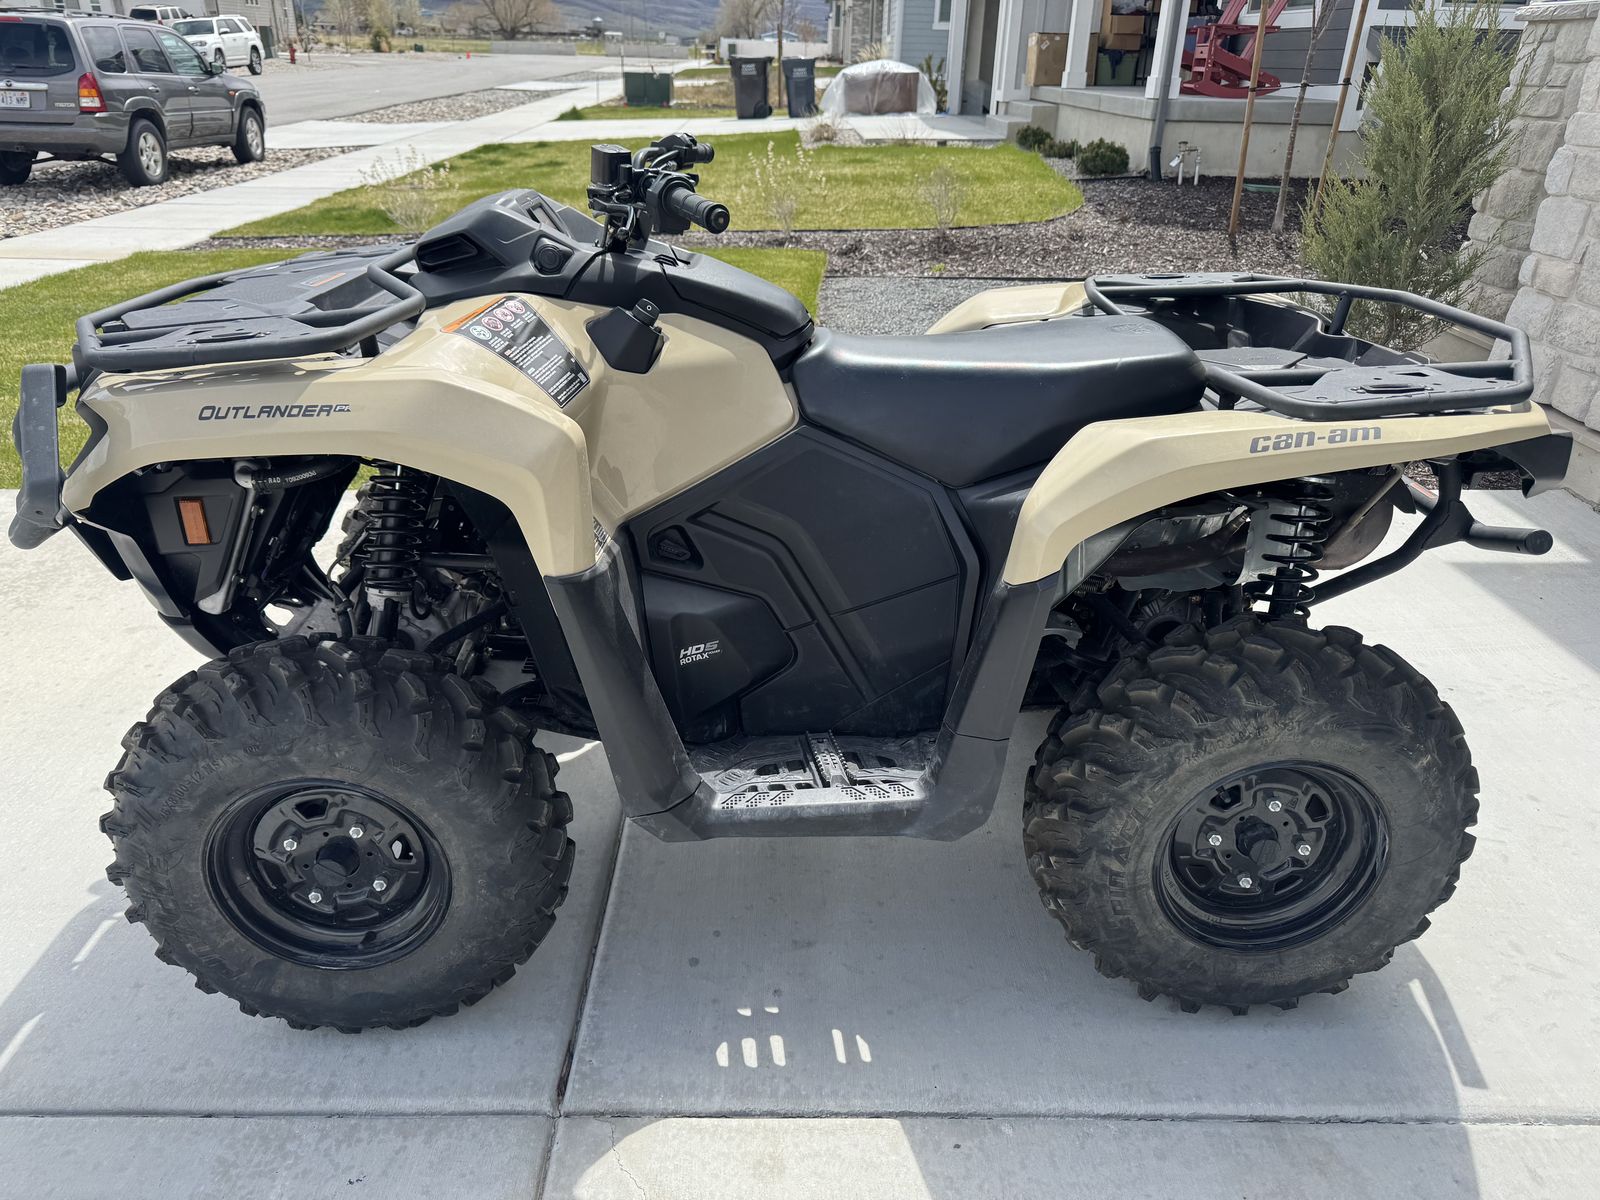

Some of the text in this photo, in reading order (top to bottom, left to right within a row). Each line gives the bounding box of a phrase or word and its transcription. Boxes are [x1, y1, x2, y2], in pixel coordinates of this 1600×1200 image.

[198, 404, 333, 421] OUTLANDER
[1249, 426, 1381, 454] can-am
[680, 652, 709, 666] ROTAX
